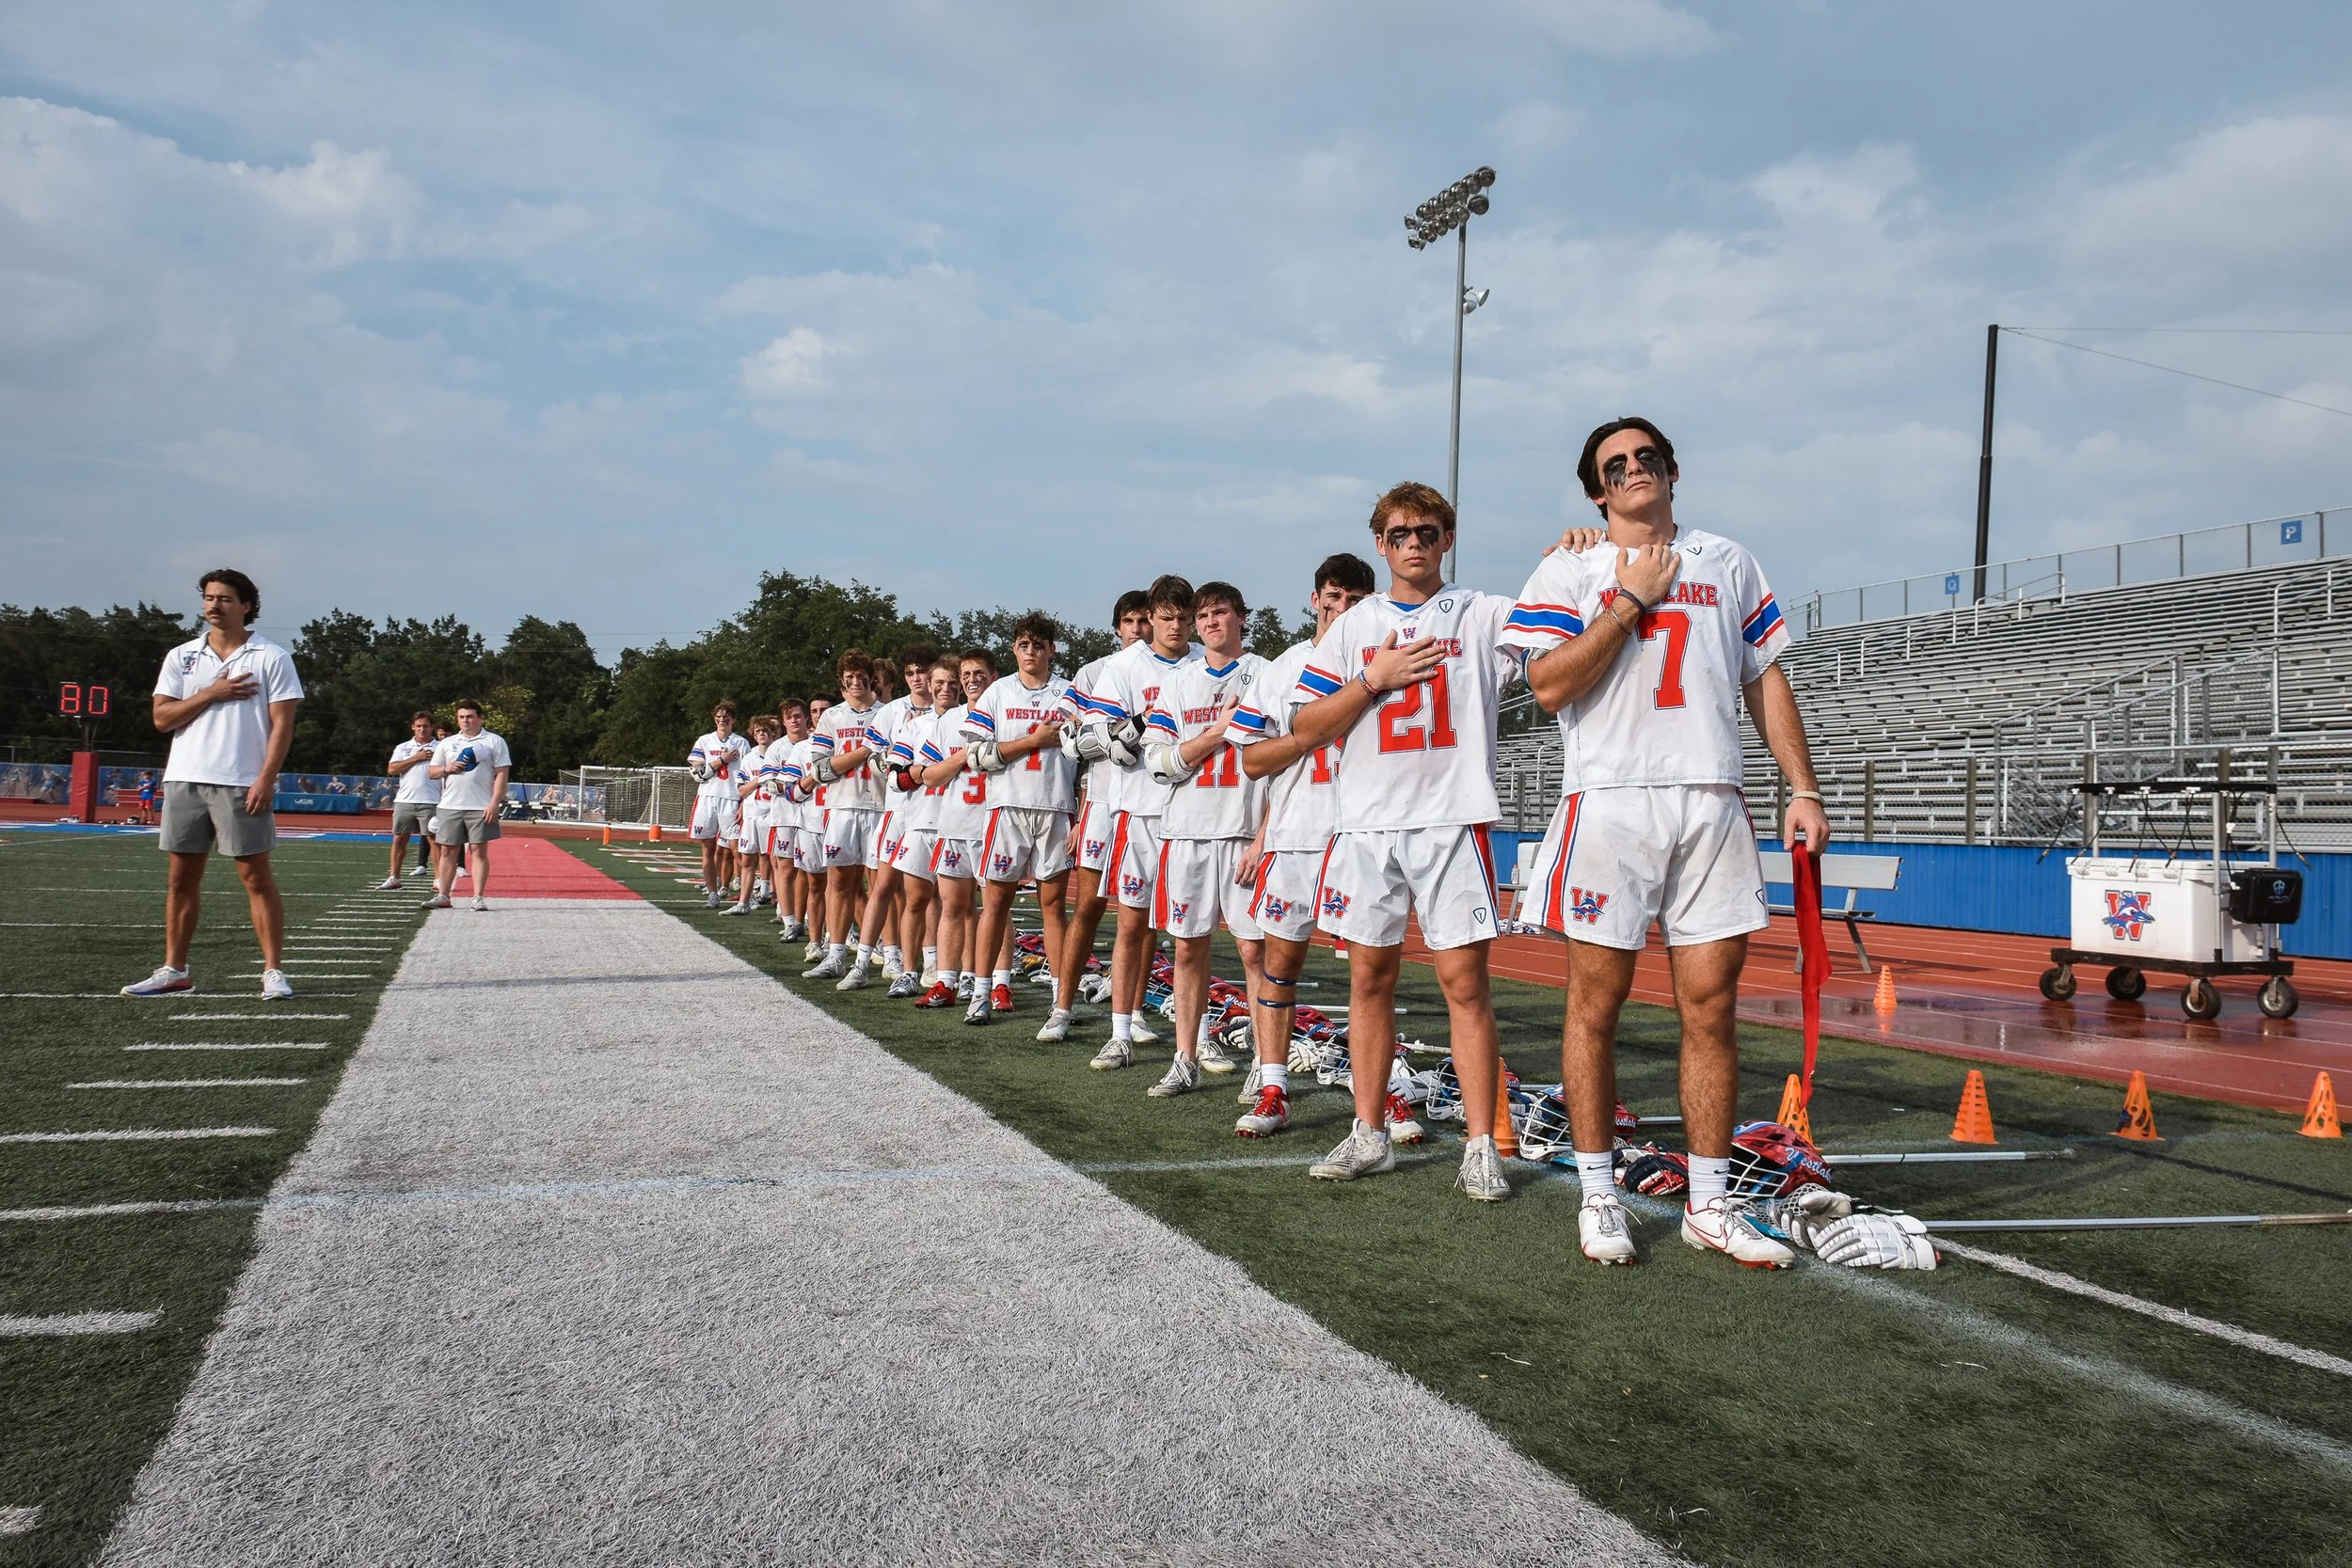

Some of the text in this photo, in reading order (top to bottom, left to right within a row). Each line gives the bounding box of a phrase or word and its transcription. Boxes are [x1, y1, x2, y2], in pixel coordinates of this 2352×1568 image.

[2285, 526, 2296, 540] P
[1597, 581, 1719, 611] WLAKE
[1947, 579, 1957, 591] Q
[1635, 610, 1692, 710] 7
[60, 684, 109, 715] 80
[1376, 661, 1457, 754] 21
[1006, 707, 1066, 722] WESTLAKE
[836, 727, 866, 738] WESTL
